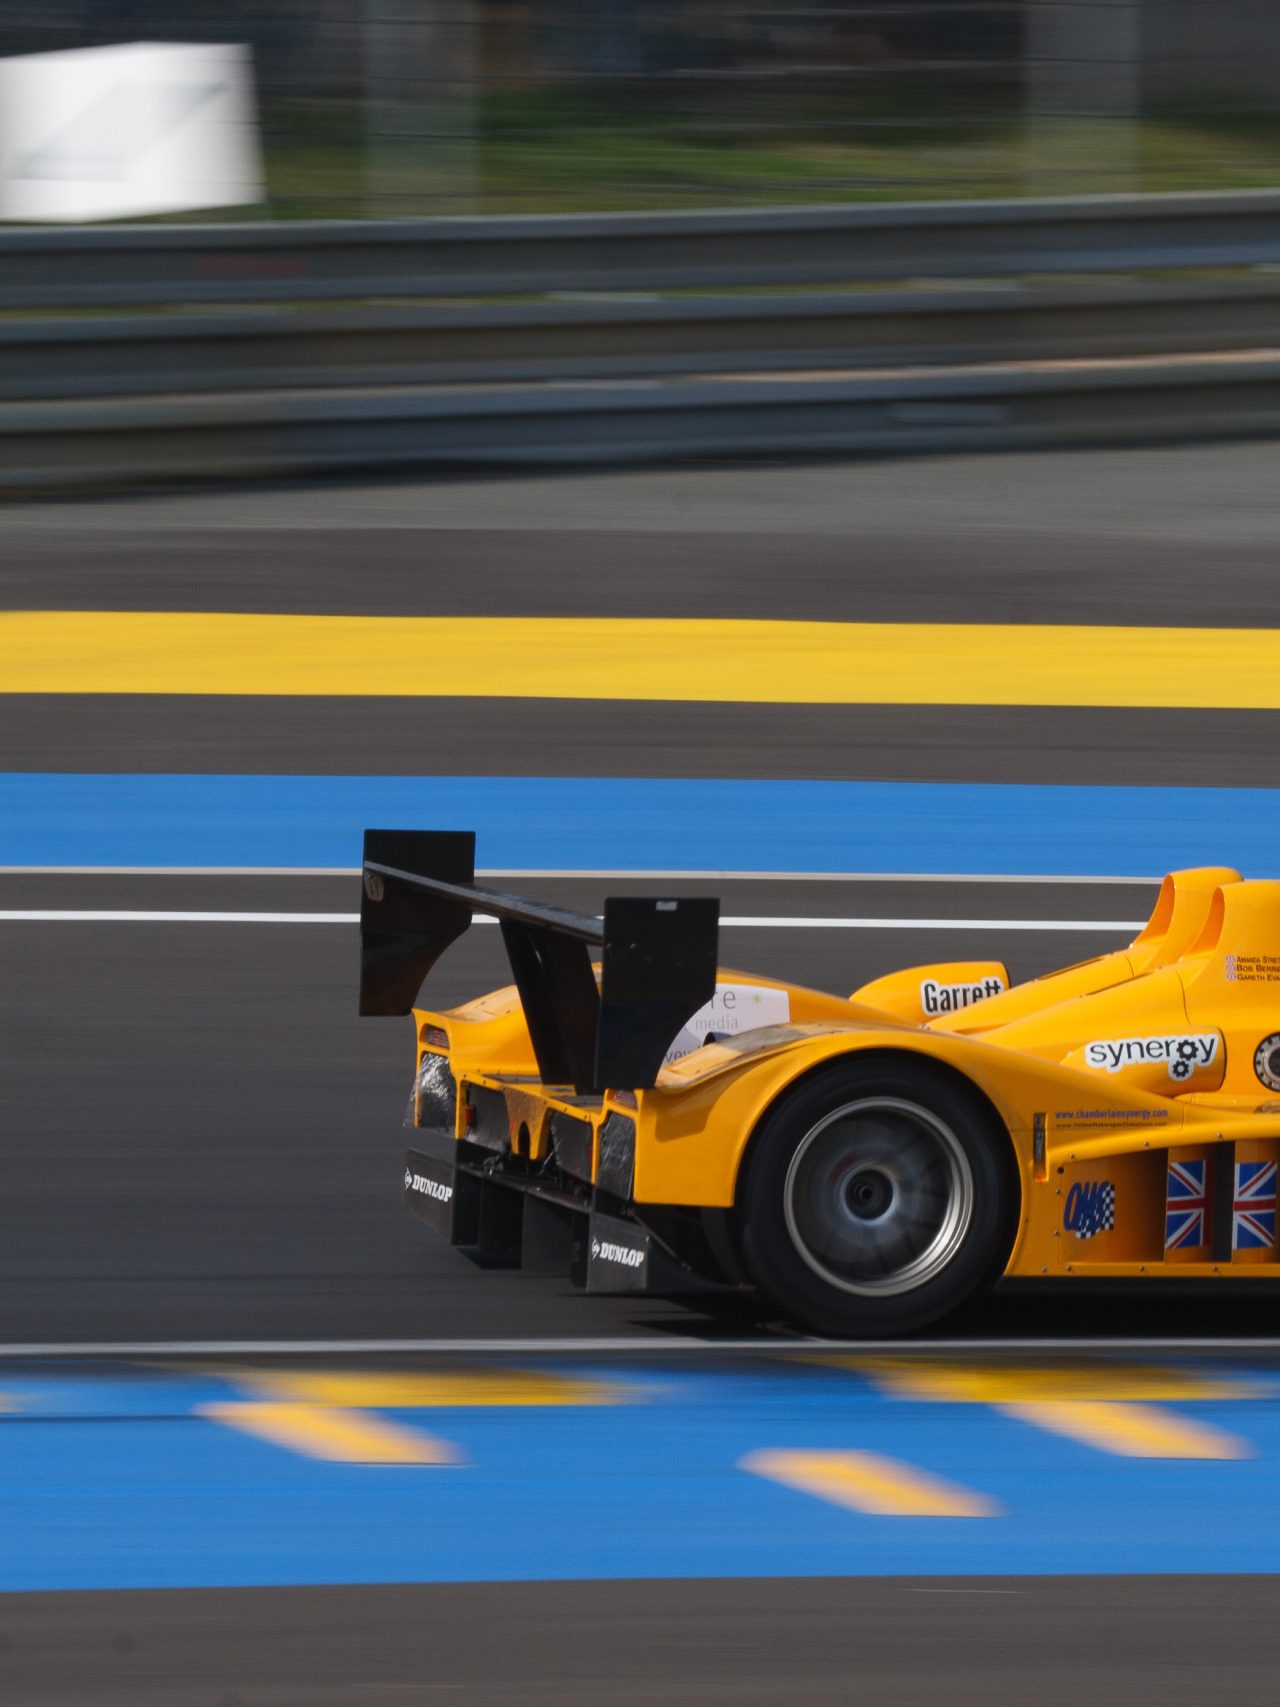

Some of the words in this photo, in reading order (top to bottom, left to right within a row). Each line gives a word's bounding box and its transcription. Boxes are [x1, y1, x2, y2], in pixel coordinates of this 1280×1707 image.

[924, 980, 1001, 1013] Garrett
[1089, 1038, 1216, 1078] synergy
[412, 1174, 453, 1202] DUNLOP
[600, 1242, 645, 1268] DUNLOP
